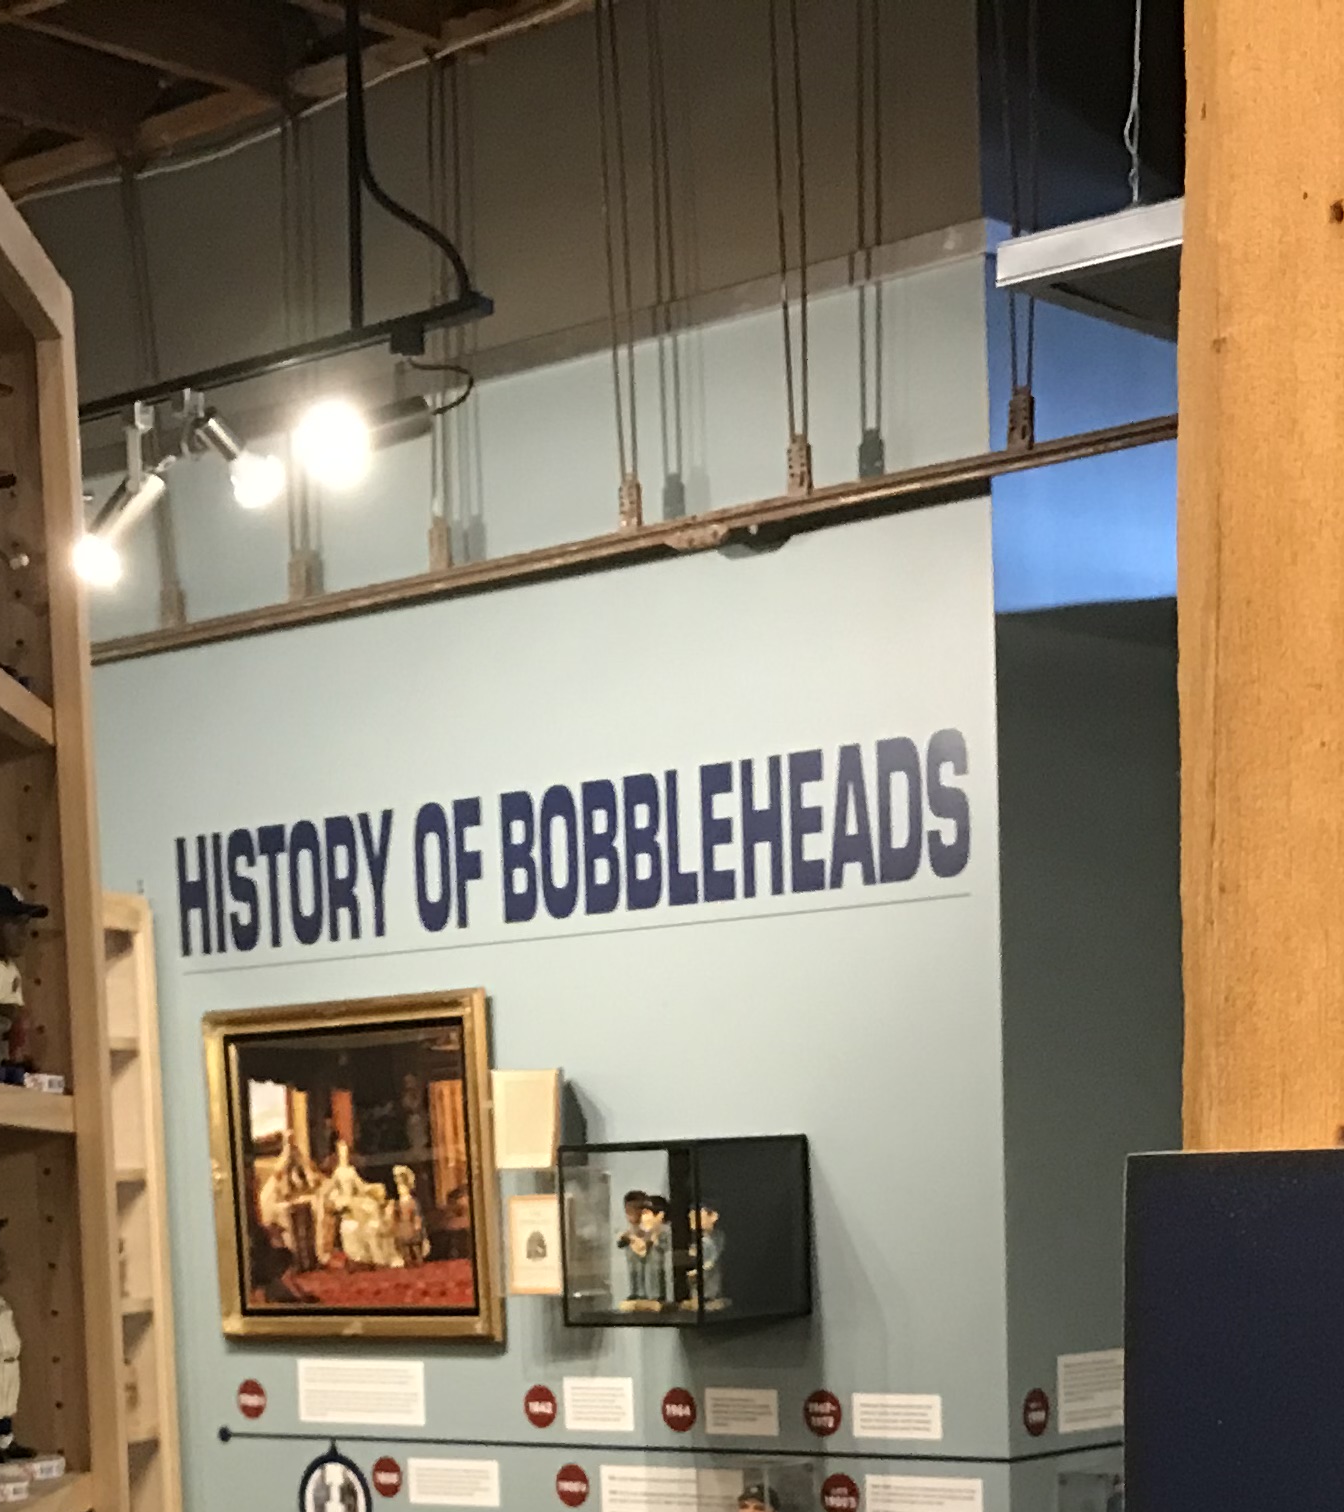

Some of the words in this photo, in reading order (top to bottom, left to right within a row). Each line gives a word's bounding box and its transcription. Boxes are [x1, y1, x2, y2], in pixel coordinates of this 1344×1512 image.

[174, 809, 393, 957] HISTORY
[414, 796, 483, 932] OF
[501, 728, 972, 922] BOBBLEHEADS
